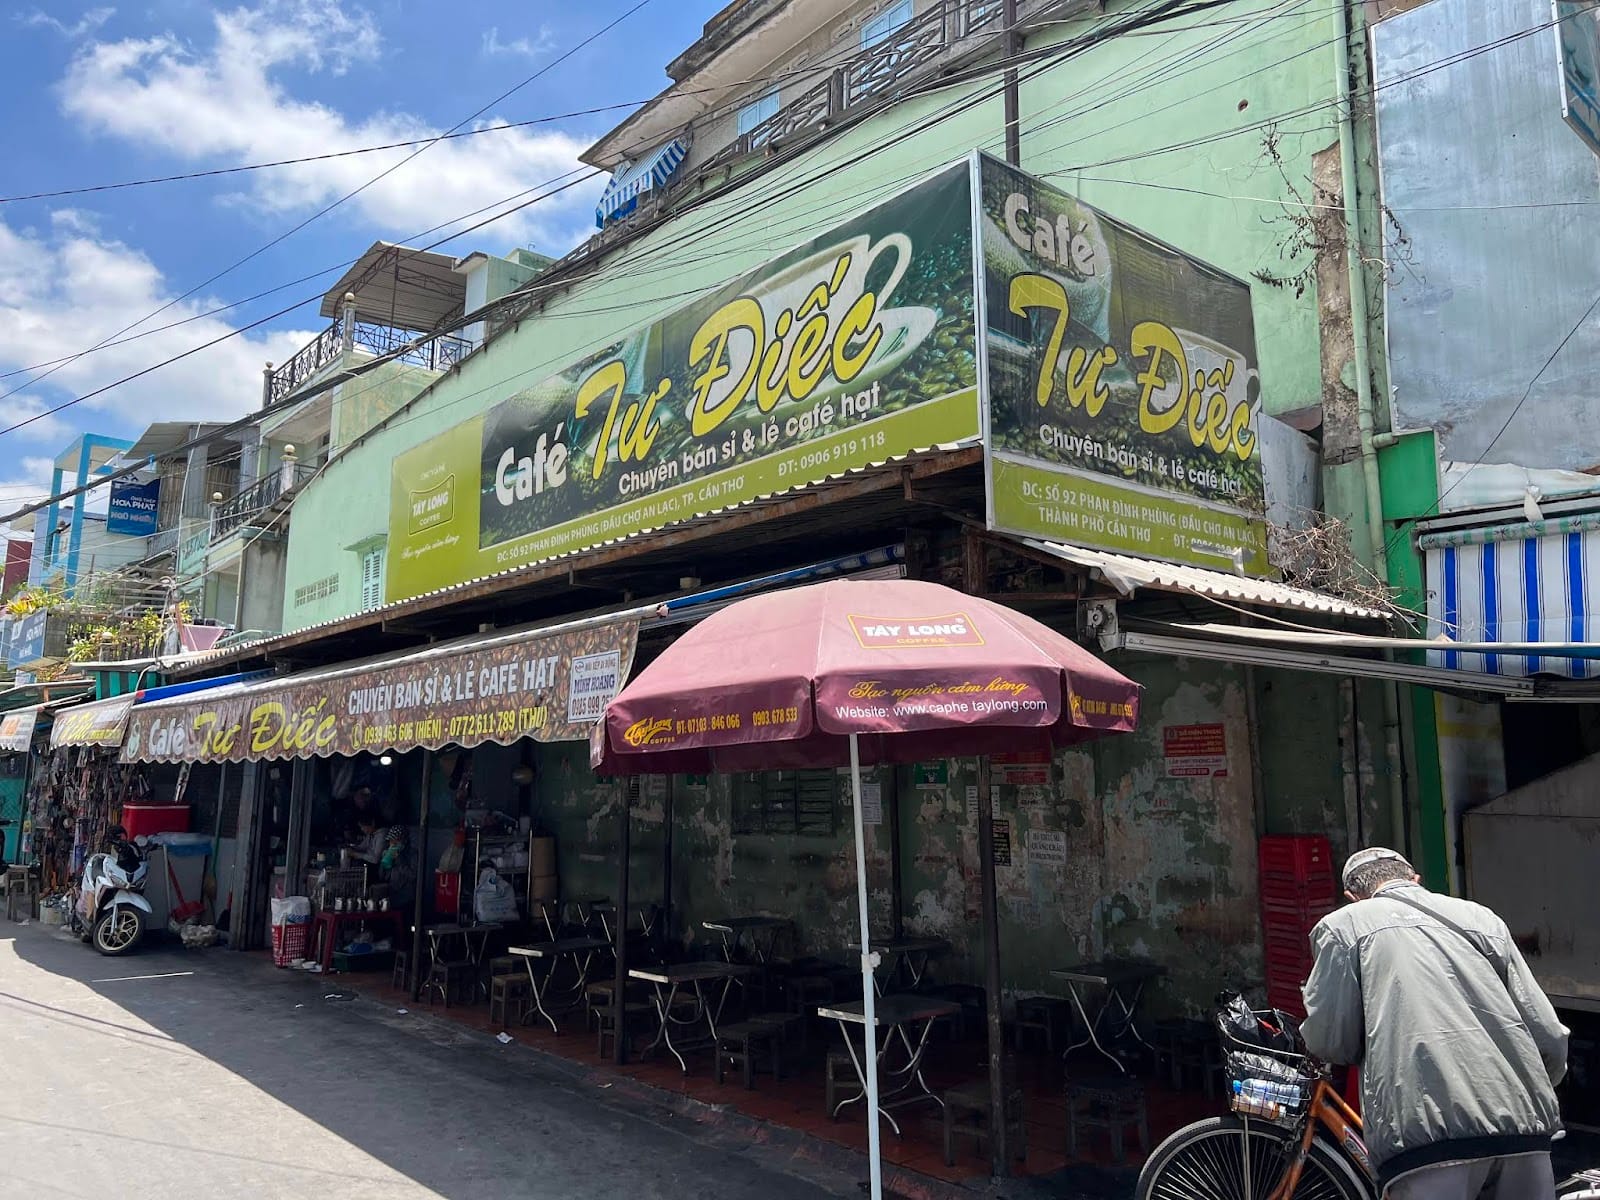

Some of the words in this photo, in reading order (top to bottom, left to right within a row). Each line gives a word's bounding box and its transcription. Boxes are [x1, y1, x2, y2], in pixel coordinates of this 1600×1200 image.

[1004, 193, 1097, 277] Café
[496, 421, 568, 506] Café
[575, 360, 672, 481] Tư
[687, 251, 884, 437] Điếc
[1009, 271, 1118, 417] Tư
[1130, 321, 1256, 461] Điếc
[619, 459, 678, 495] Chuyên
[682, 444, 716, 473] bán
[722, 431, 736, 460] sỉ
[742, 428, 755, 452] &
[761, 415, 779, 446] lẻ
[786, 396, 835, 436] café
[841, 381, 881, 422] hạt
[1040, 424, 1103, 459] Chuyên
[1109, 443, 1137, 468] bán
[1142, 451, 1153, 472] sỉ
[1157, 457, 1168, 476] &
[1172, 458, 1184, 480] lẻ
[1188, 466, 1217, 489] café
[419, 512, 441, 526] COFFEE
[428, 491, 448, 511] LONG
[497, 552, 508, 562] ĐC:
[520, 545, 528, 556] 92
[530, 539, 550, 552] PHAN
[551, 532, 570, 546] ĐÌNH
[571, 523, 599, 541] PHÙNG
[623, 507, 641, 524] CHỢ
[643, 504, 656, 518] AN
[682, 493, 697, 506] TP.
[722, 475, 745, 492] THƠ
[778, 459, 798, 476] ĐT:
[800, 449, 830, 469] 0906
[833, 440, 857, 460] 919
[861, 431, 885, 451] 118
[1023, 481, 1042, 499] ĐC:
[1046, 483, 1060, 501] SỐ
[1063, 490, 1076, 505] 92
[1080, 493, 1110, 512] PHAN
[1113, 500, 1139, 519] ĐÌNH
[1142, 506, 1175, 526] PHÙNG
[1224, 526, 1235, 540] AN
[1039, 506, 1078, 528] THÀNH
[1082, 514, 1104, 533] PHỐ
[1107, 517, 1127, 538] CẦN
[1130, 526, 1151, 542] THƠ
[908, 624, 967, 636] LONG
[349, 680, 392, 715] CHUYÊN
[395, 674, 421, 709] BÁN
[424, 667, 439, 705] SỈ
[441, 674, 452, 703] &
[455, 660, 475, 701] LẺ
[479, 655, 519, 697] CAFÉ
[523, 656, 558, 695] HẠT
[786, 707, 798, 722] 533
[835, 705, 890, 720] Website:
[893, 699, 969, 718] www.caphe
[972, 699, 1049, 715] taylong.com
[194, 711, 241, 757] Tư
[251, 697, 337, 753] Điếc
[364, 726, 382, 745] 0939
[384, 724, 397, 742] 463
[450, 716, 475, 736] 0772
[477, 713, 494, 734] 611
[497, 710, 516, 732] 789
[650, 736, 675, 744] COFFEE
